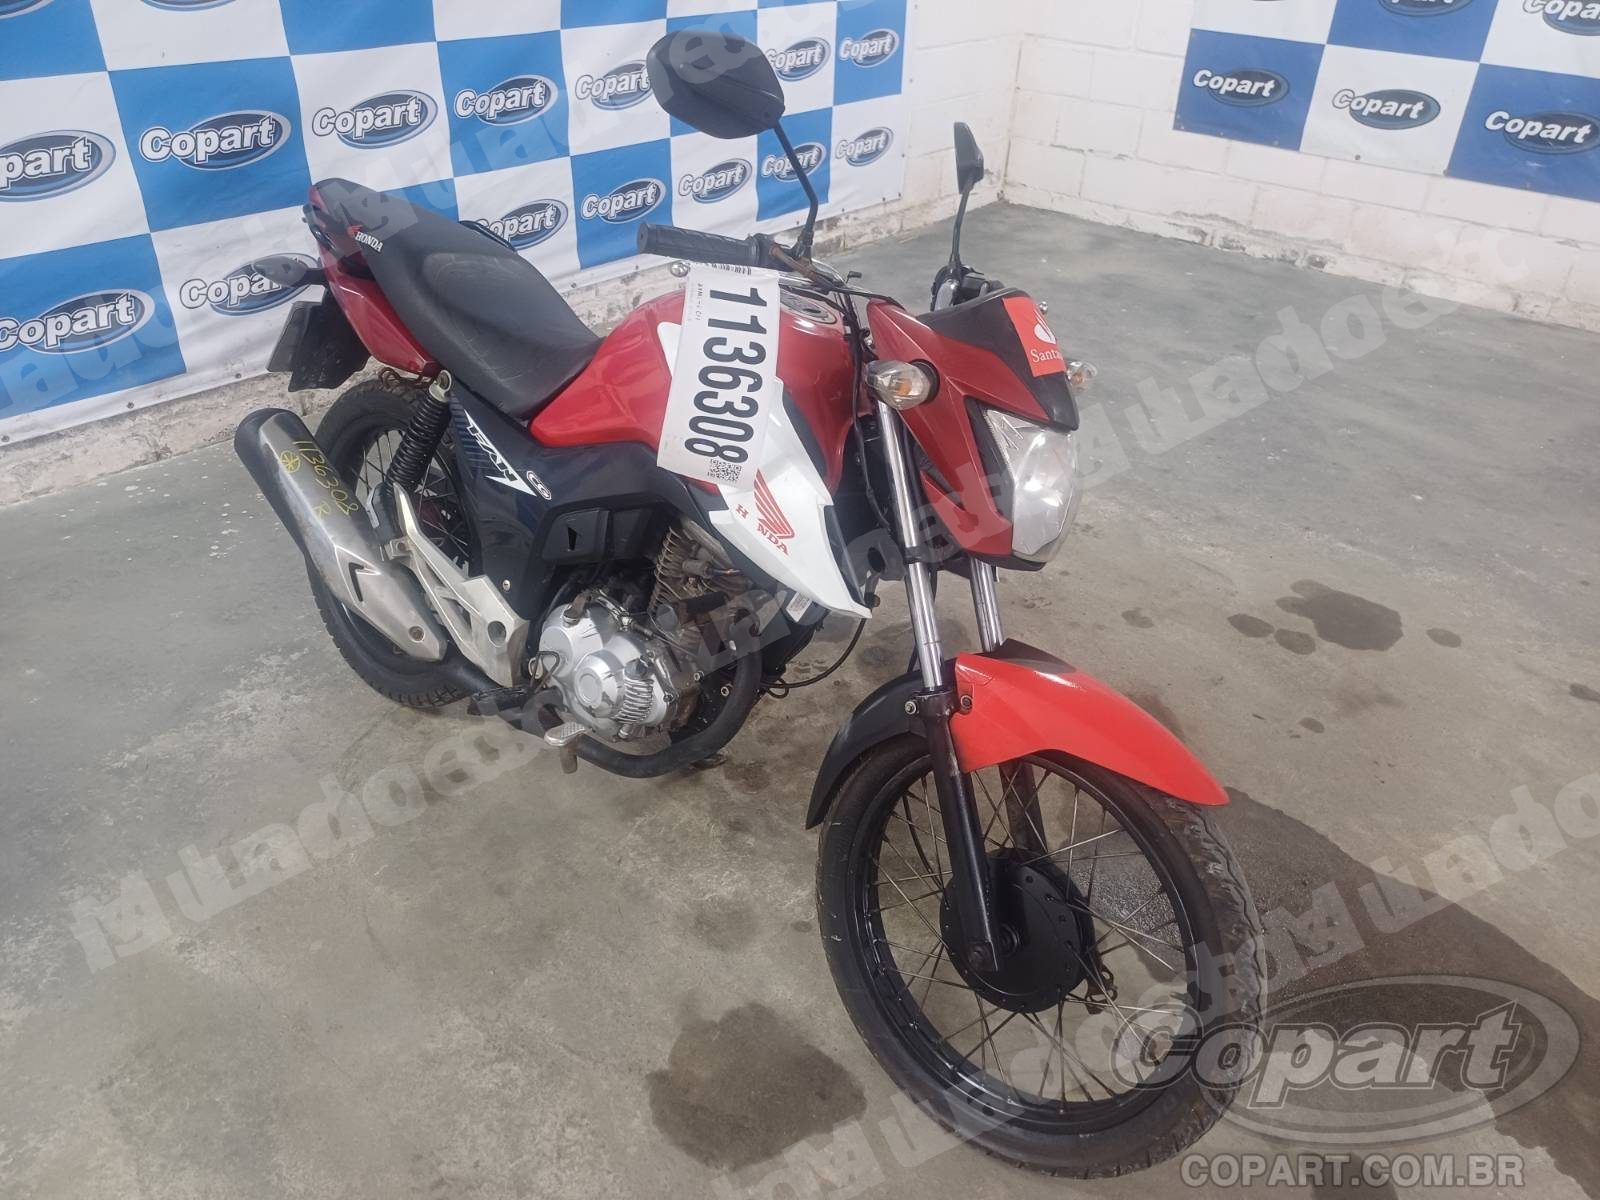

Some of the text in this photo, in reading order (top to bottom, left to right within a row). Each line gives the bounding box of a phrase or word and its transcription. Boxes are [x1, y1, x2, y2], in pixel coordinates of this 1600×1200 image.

[1522, 0, 1600, 20] Copa
[839, 33, 894, 62] Copart
[454, 79, 546, 119] Copart
[574, 66, 651, 102] Copart
[1193, 69, 1276, 98] Copart
[312, 96, 423, 139] Copart
[1332, 89, 1425, 120] Copart
[139, 114, 278, 163] Copart
[1485, 111, 1592, 144] Copart
[761, 148, 820, 178] Coprt
[836, 132, 887, 160] Copart
[678, 163, 746, 197] Copart
[581, 179, 658, 219] Copart
[476, 202, 557, 243] opart
[355, 231, 383, 252] HONDA
[180, 257, 300, 309] Copa
[0, 290, 136, 351] Copart
[684, 287, 768, 464] 1136308
[292, 441, 358, 515] 1136308
[527, 471, 551, 499] CG
